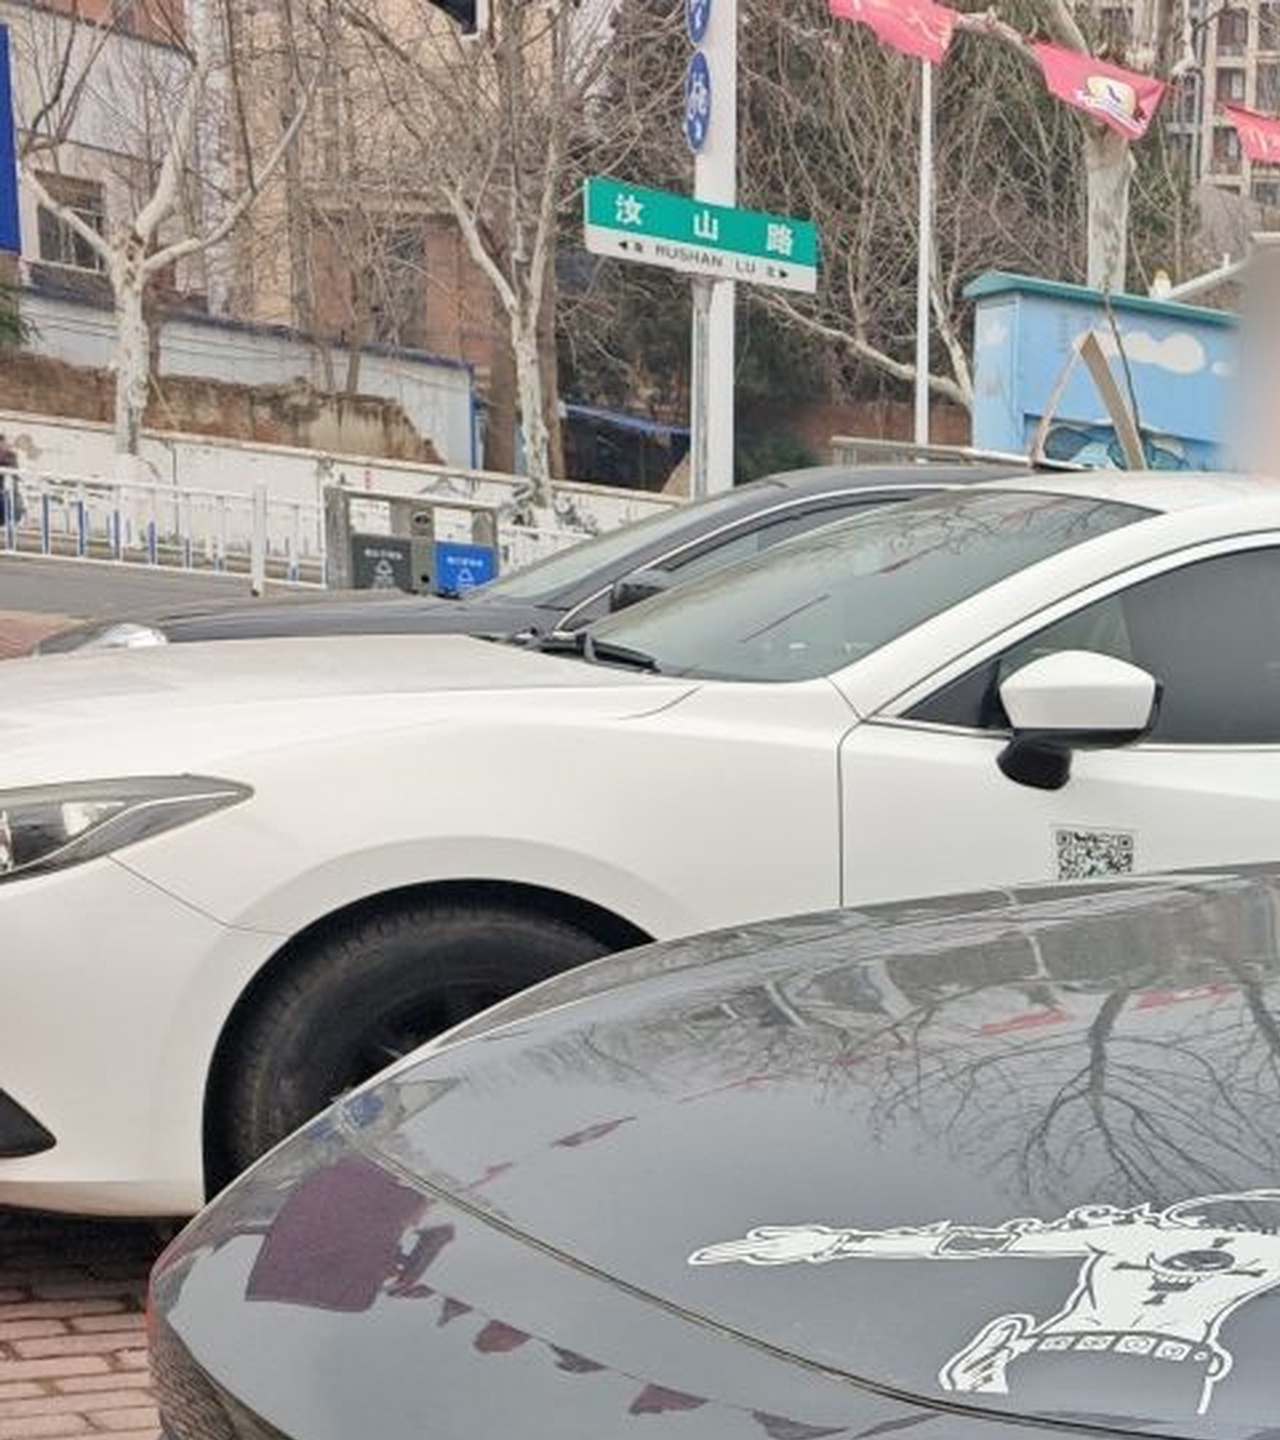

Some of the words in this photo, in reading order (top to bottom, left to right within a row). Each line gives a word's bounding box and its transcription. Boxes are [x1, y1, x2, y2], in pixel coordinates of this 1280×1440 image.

[615, 193, 793, 256] 汝山路
[655, 245, 723, 268] RUSHAN
[735, 259, 756, 273] LU
